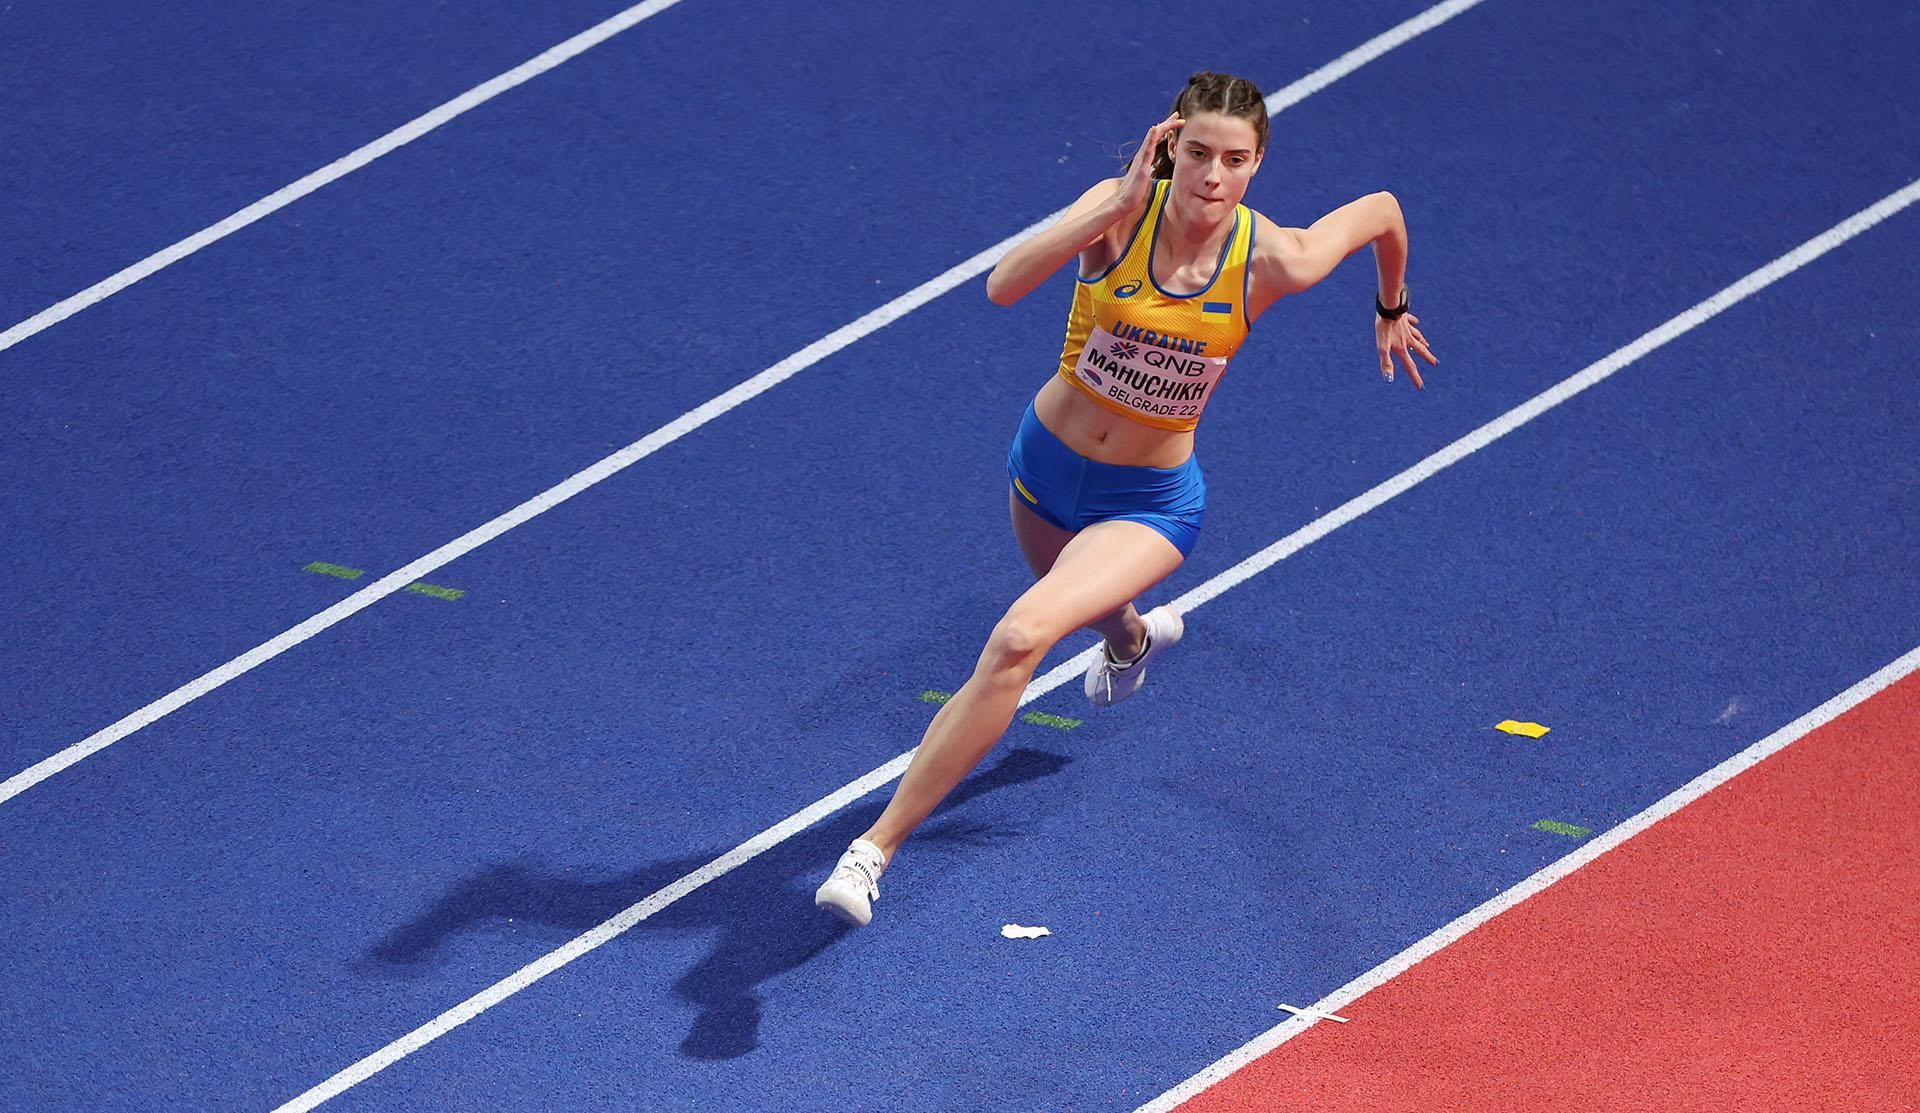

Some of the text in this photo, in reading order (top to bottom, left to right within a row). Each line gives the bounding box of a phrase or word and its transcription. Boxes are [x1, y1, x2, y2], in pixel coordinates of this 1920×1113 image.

[1112, 320, 1207, 356] UKRAINE
[1087, 348, 1208, 401] MAHUCHIKH
[1144, 350, 1206, 377] QNB
[1108, 385, 1198, 416] BELGRADE 22
